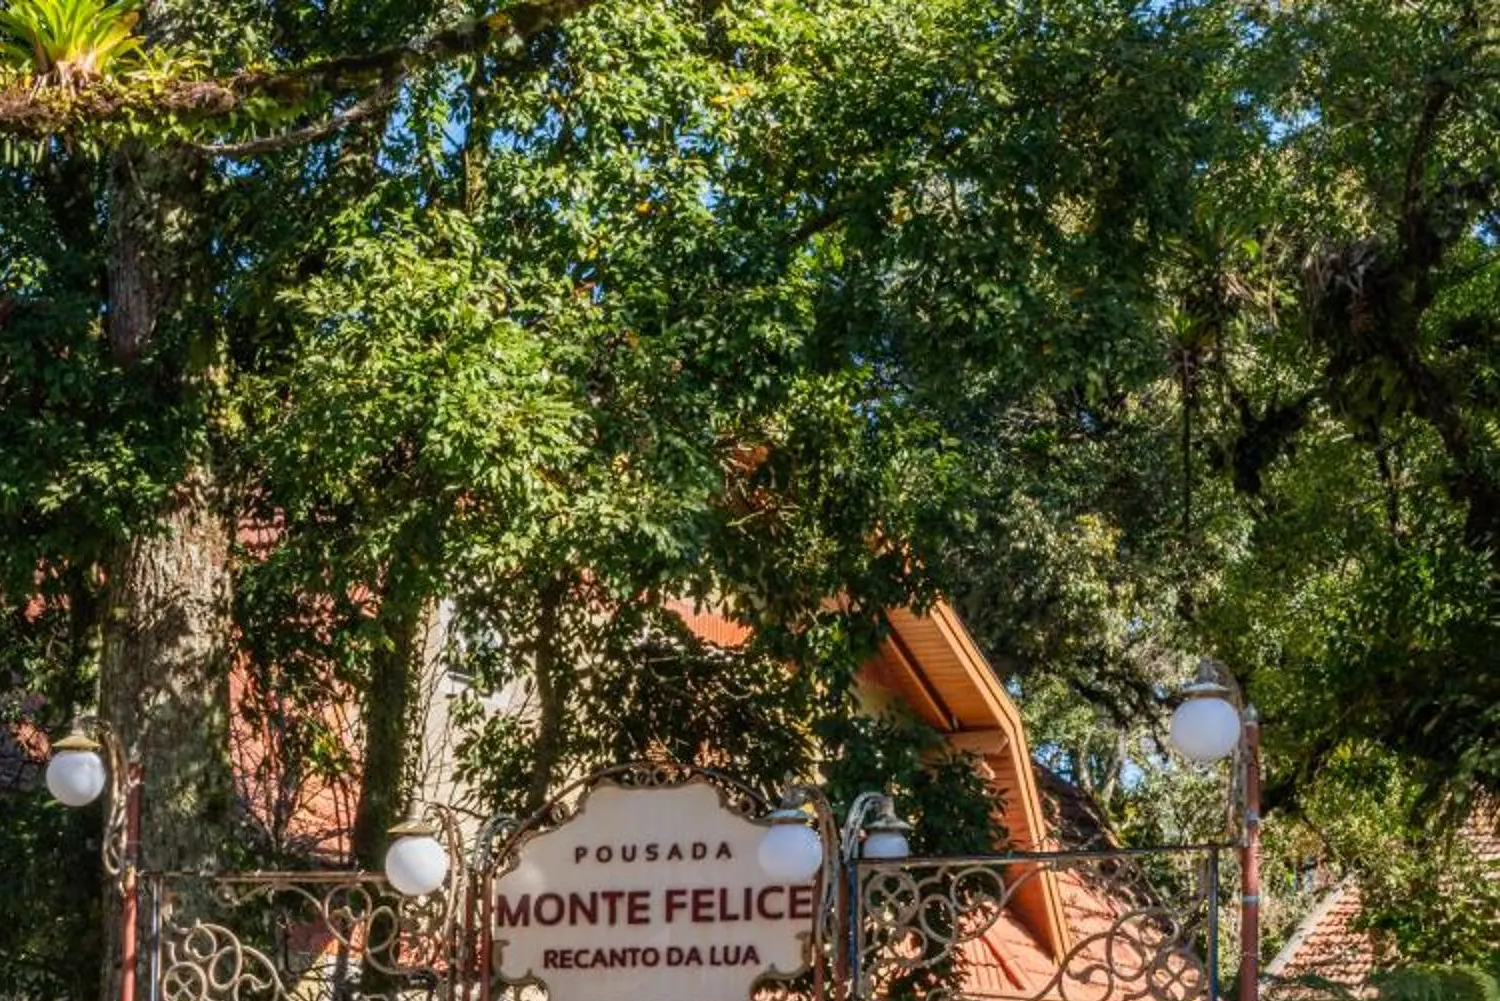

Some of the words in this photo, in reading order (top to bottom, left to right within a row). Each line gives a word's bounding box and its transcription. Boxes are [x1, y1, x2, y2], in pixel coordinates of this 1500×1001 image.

[575, 842, 732, 864] POUSADA
[497, 890, 650, 928] MONTE
[665, 885, 813, 923] FELICE
[543, 946, 660, 970] RECANTO
[666, 946, 702, 967] DA
[710, 944, 760, 966] LUA
